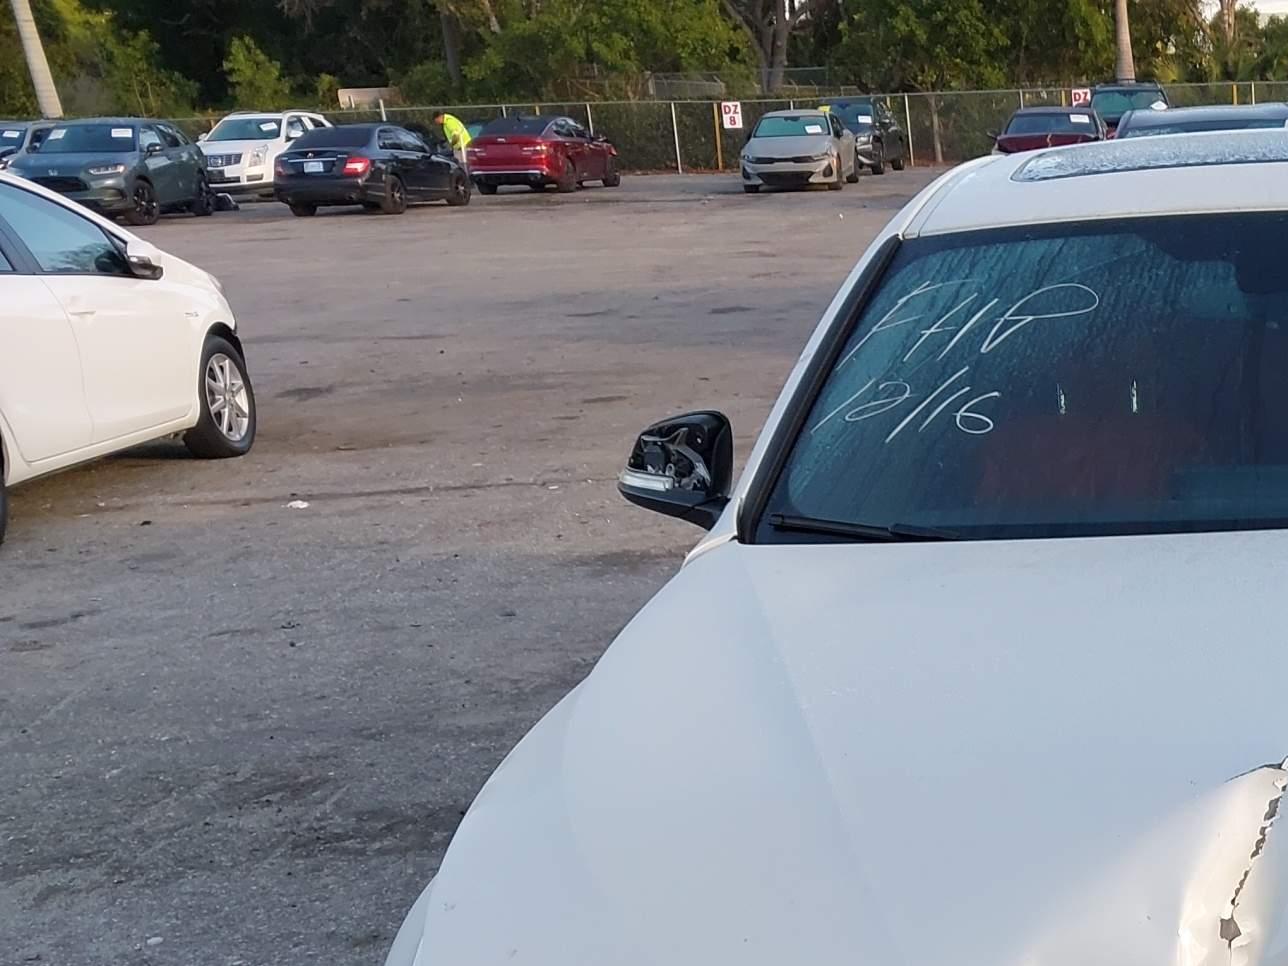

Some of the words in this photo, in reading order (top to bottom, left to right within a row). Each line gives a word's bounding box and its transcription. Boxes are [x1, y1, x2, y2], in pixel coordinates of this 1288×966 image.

[1073, 92, 1088, 102] DZ
[724, 105, 739, 115] DZ
[730, 117, 736, 126] 8
[810, 365, 1001, 444] 12/16
